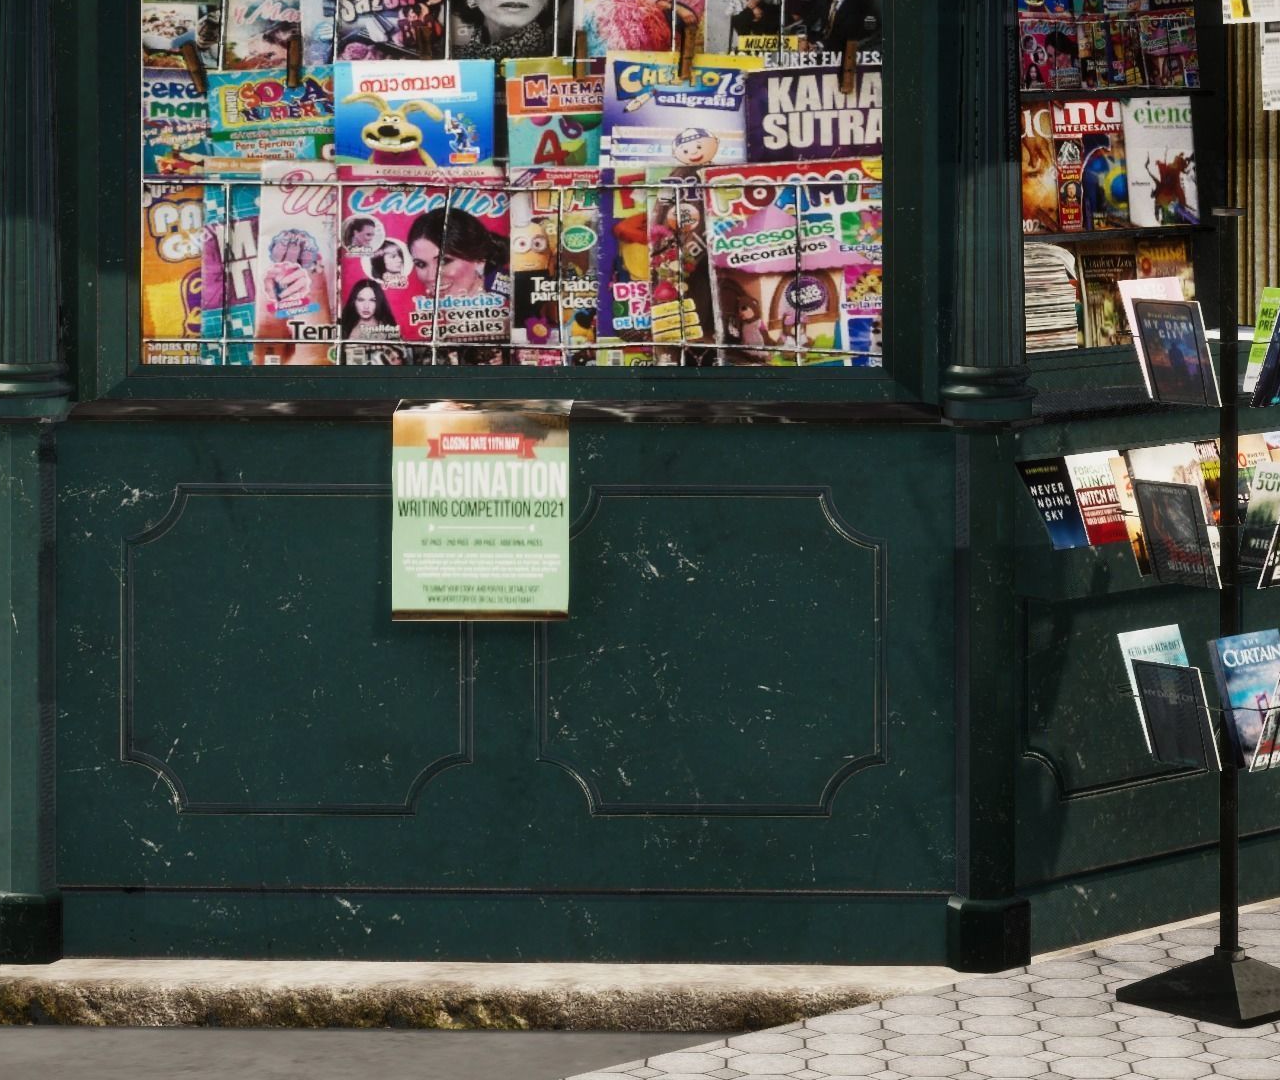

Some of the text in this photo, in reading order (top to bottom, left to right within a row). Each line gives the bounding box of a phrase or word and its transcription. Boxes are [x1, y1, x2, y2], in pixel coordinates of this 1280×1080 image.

[744, 37, 793, 51] MUJERS,
[768, 72, 882, 114] KAMA
[763, 108, 882, 151] SUTRA
[1055, 124, 1121, 133] INTERESANT
[715, 221, 835, 251] Accesorios
[729, 241, 828, 265] decorativos
[447, 307, 509, 319] eventos
[442, 436, 520, 451] CLOSING DATE 11TH MAY
[397, 459, 567, 499] IMAGINATION
[1030, 482, 1065, 497] NEVER
[397, 499, 564, 518] WRITING COMPETITION 2021
[1044, 509, 1064, 522] SKY
